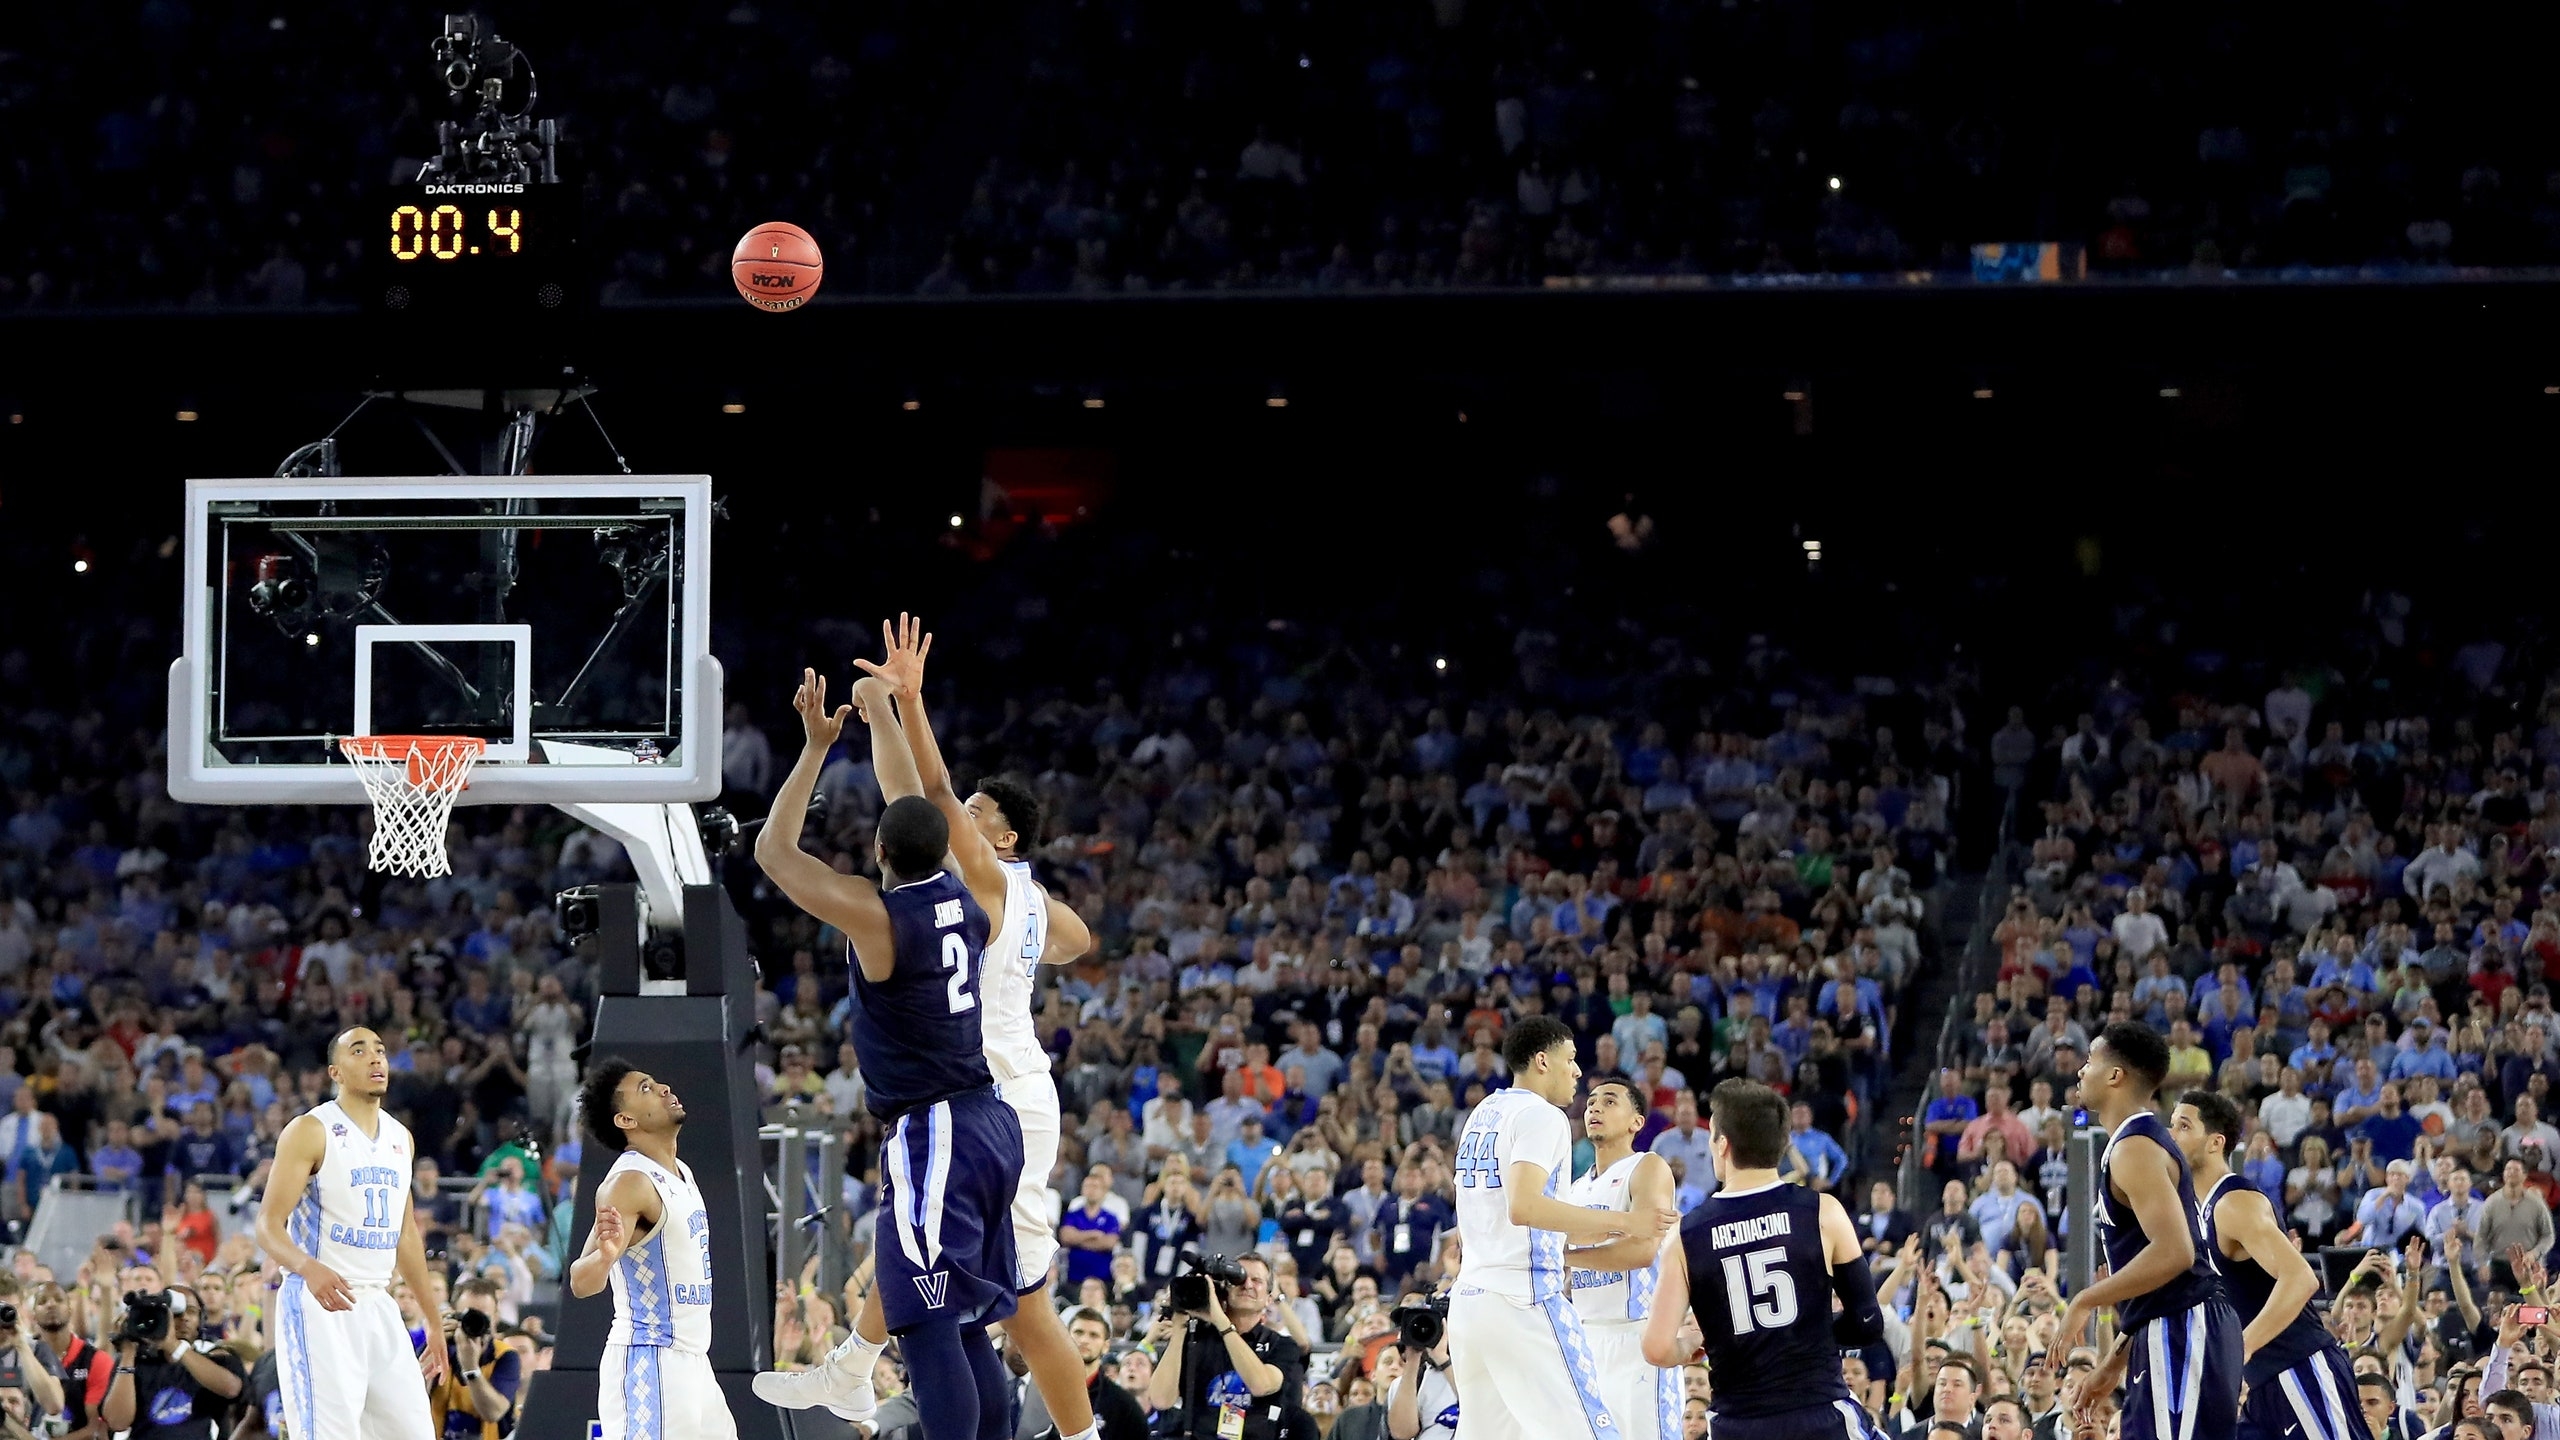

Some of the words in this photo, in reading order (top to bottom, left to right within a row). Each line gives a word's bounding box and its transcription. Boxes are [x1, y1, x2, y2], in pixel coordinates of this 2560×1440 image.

[425, 183, 524, 195] DAKTRONICS
[391, 205, 520, 260] 00.4
[752, 273, 795, 288] NCAA
[942, 932, 975, 1014] 2
[351, 1166, 399, 1189] NORTH
[1456, 1131, 1502, 1188] 44
[363, 1187, 390, 1228] 11
[330, 1223, 400, 1250] CAROLIN
[1711, 1212, 1791, 1250] ARCIDIACONO
[912, 1270, 949, 1310] V
[1720, 1246, 1798, 1336] 15
[1255, 1342, 1270, 1352] 21
